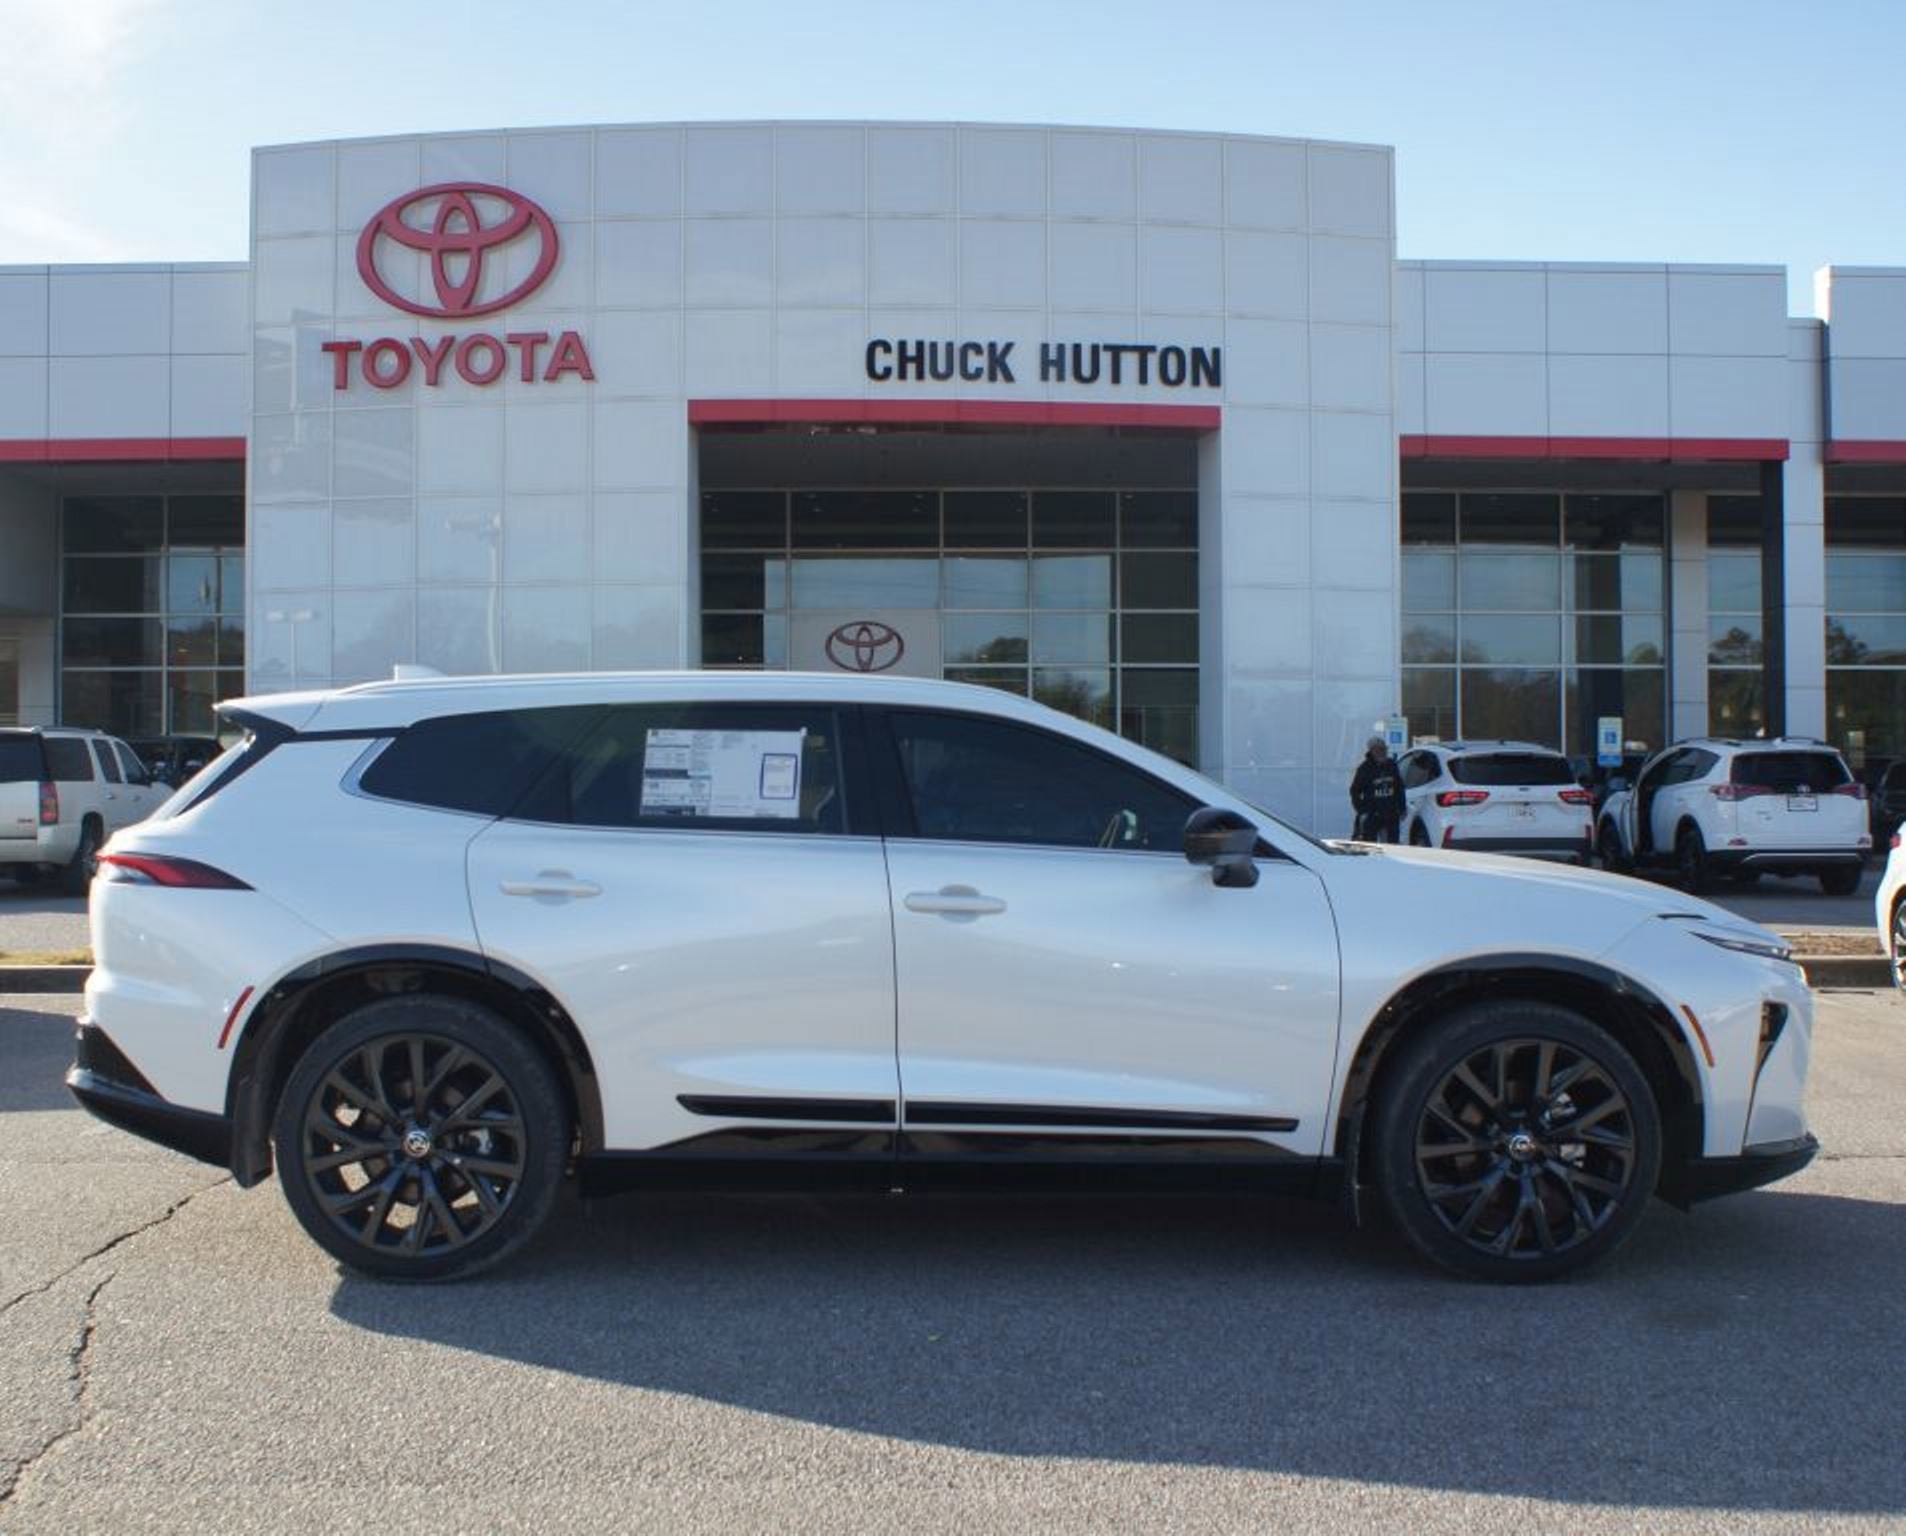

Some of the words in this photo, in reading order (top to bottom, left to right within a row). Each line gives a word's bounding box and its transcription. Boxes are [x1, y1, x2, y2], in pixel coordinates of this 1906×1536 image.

[321, 331, 595, 390] TOYOTA
[865, 339, 1016, 384] CHUCK
[1039, 343, 1222, 388] HUTTON
